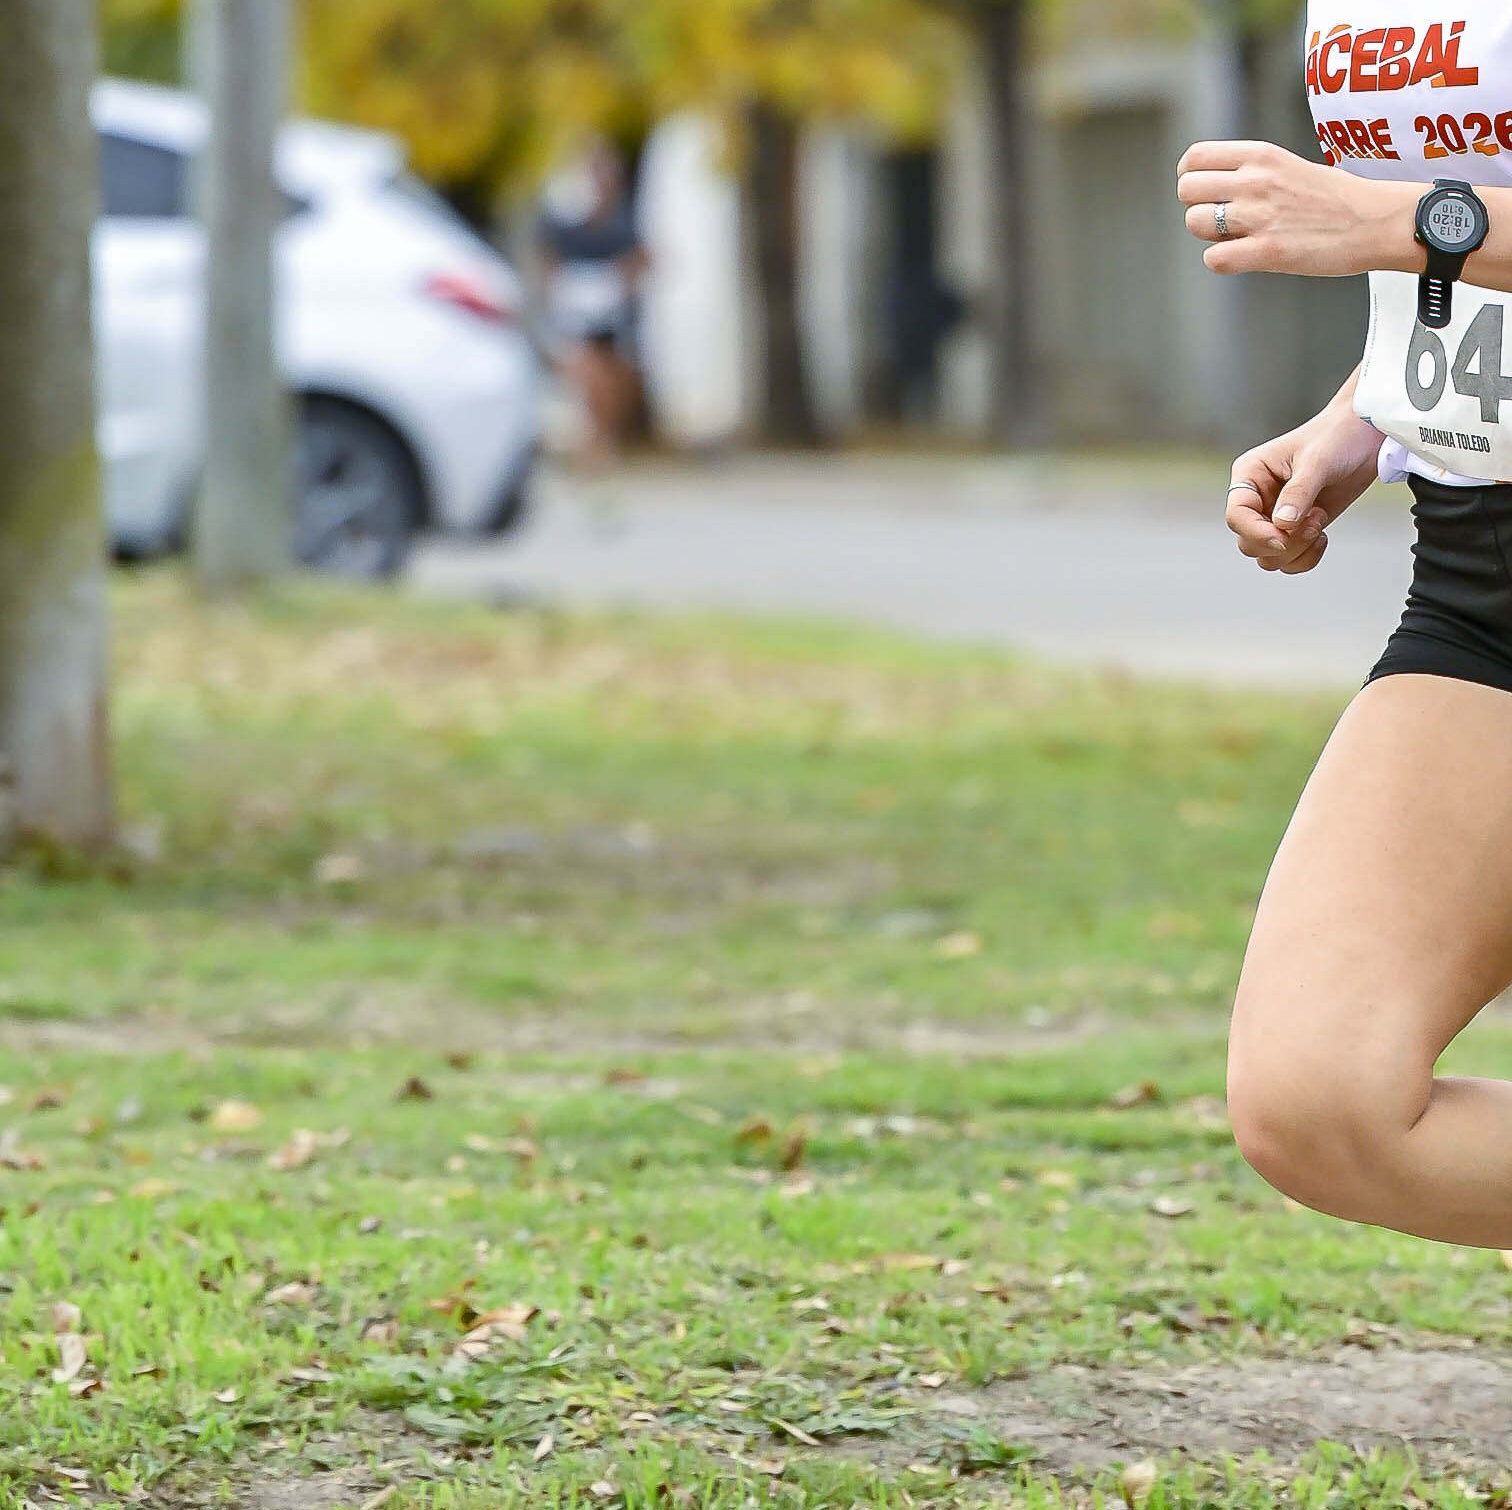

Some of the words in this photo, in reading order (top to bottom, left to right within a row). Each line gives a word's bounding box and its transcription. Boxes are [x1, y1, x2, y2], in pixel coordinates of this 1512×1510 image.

[1306, 21, 1479, 96] ACEBAL
[1442, 203, 1464, 215] 6:10
[1433, 213, 1470, 228] 18:20
[1418, 426, 1456, 448] BRIANNA
[1455, 432, 1491, 453] TOLEDO
